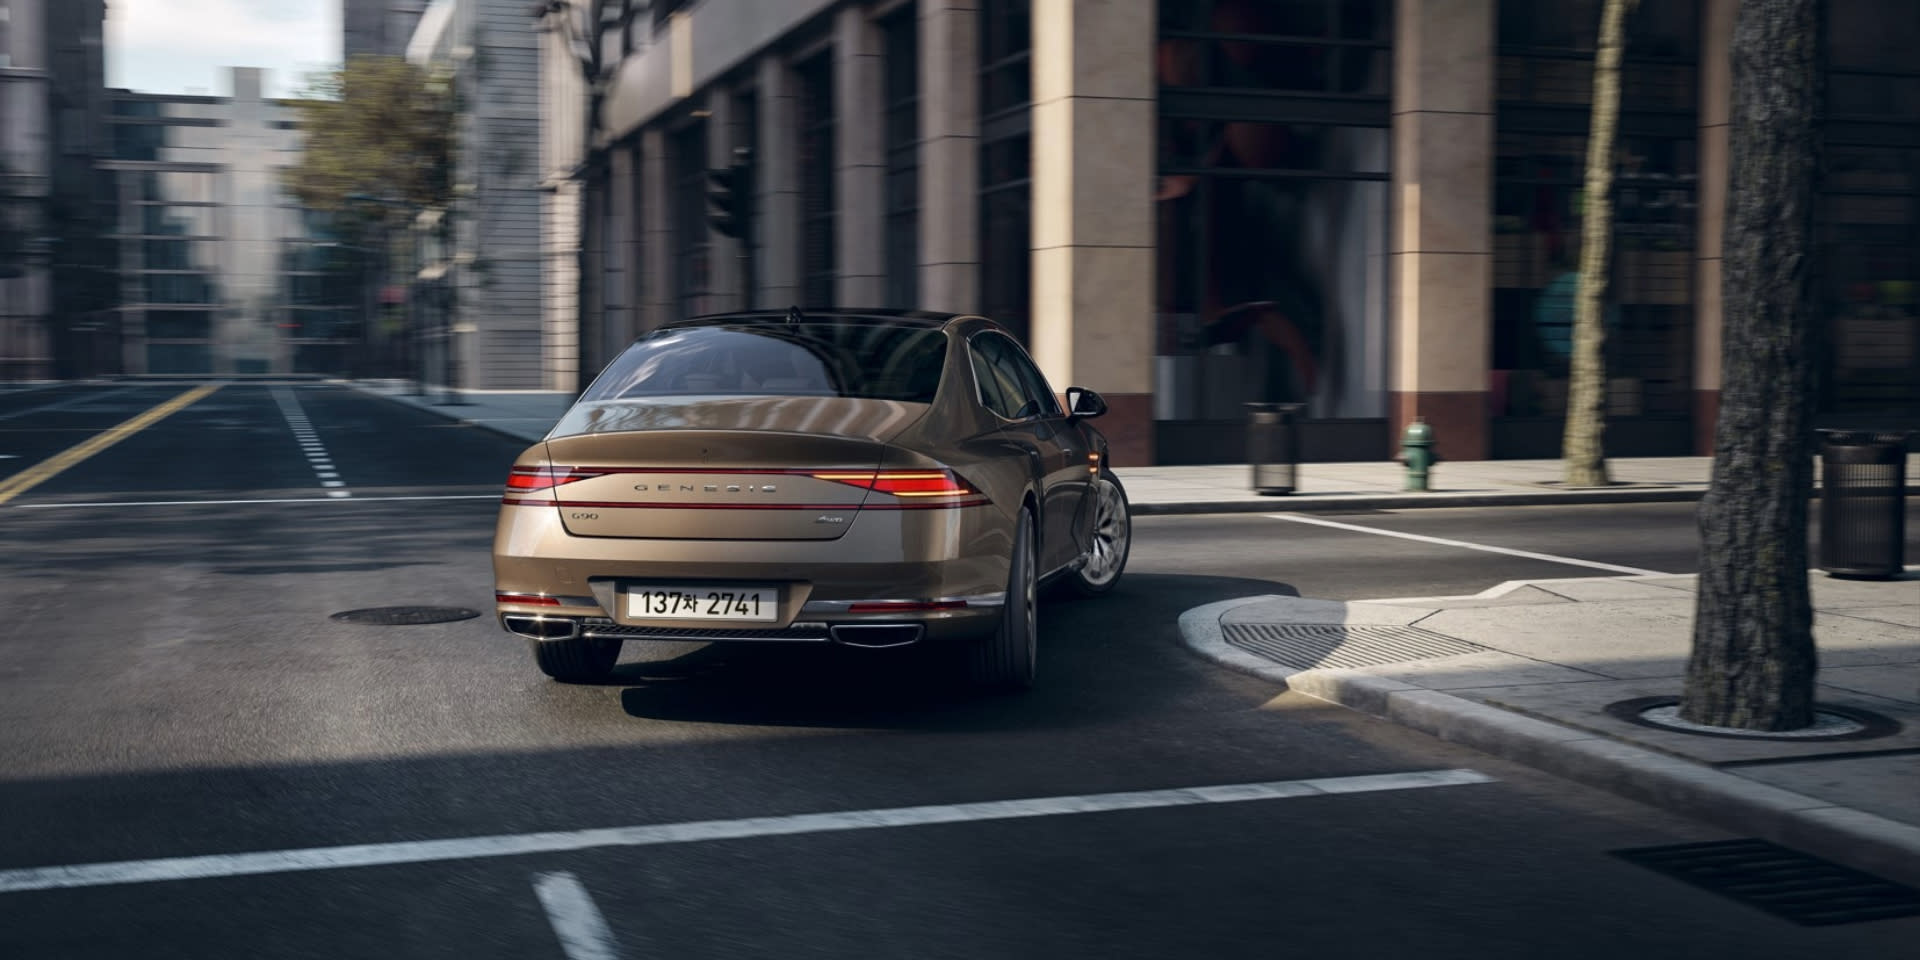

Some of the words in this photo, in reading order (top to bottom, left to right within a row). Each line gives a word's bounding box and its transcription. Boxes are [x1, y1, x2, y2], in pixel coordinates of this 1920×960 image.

[634, 484, 777, 493] GENESIS
[571, 512, 599, 520] G90
[641, 590, 699, 614] 137차
[706, 591, 761, 616] 2741
